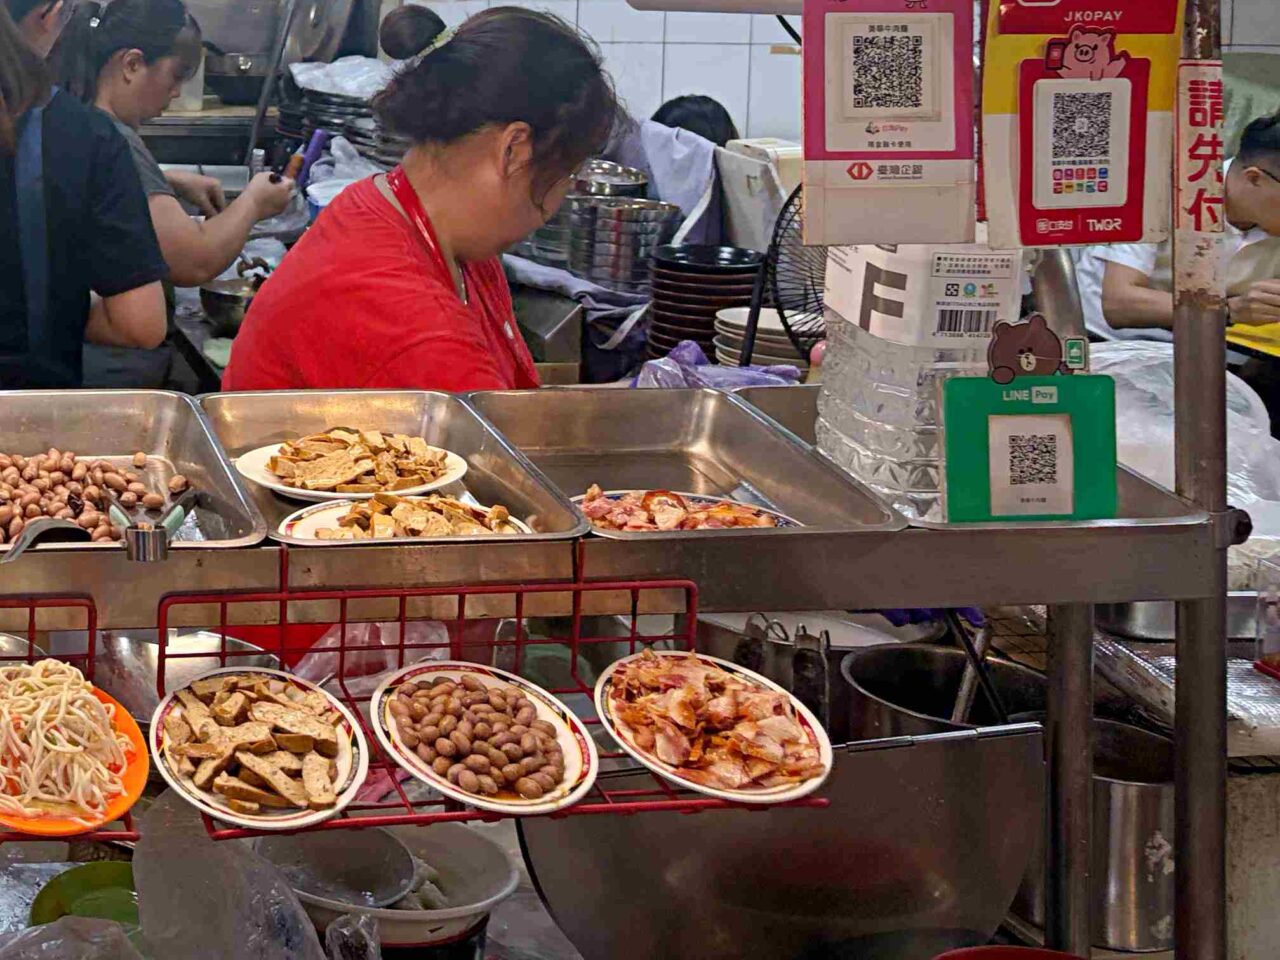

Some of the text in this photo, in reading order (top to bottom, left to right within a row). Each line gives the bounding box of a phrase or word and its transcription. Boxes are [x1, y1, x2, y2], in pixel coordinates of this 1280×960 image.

[1064, 11, 1122, 21] JKOPAY
[1003, 390, 1054, 401] LINE Pay
